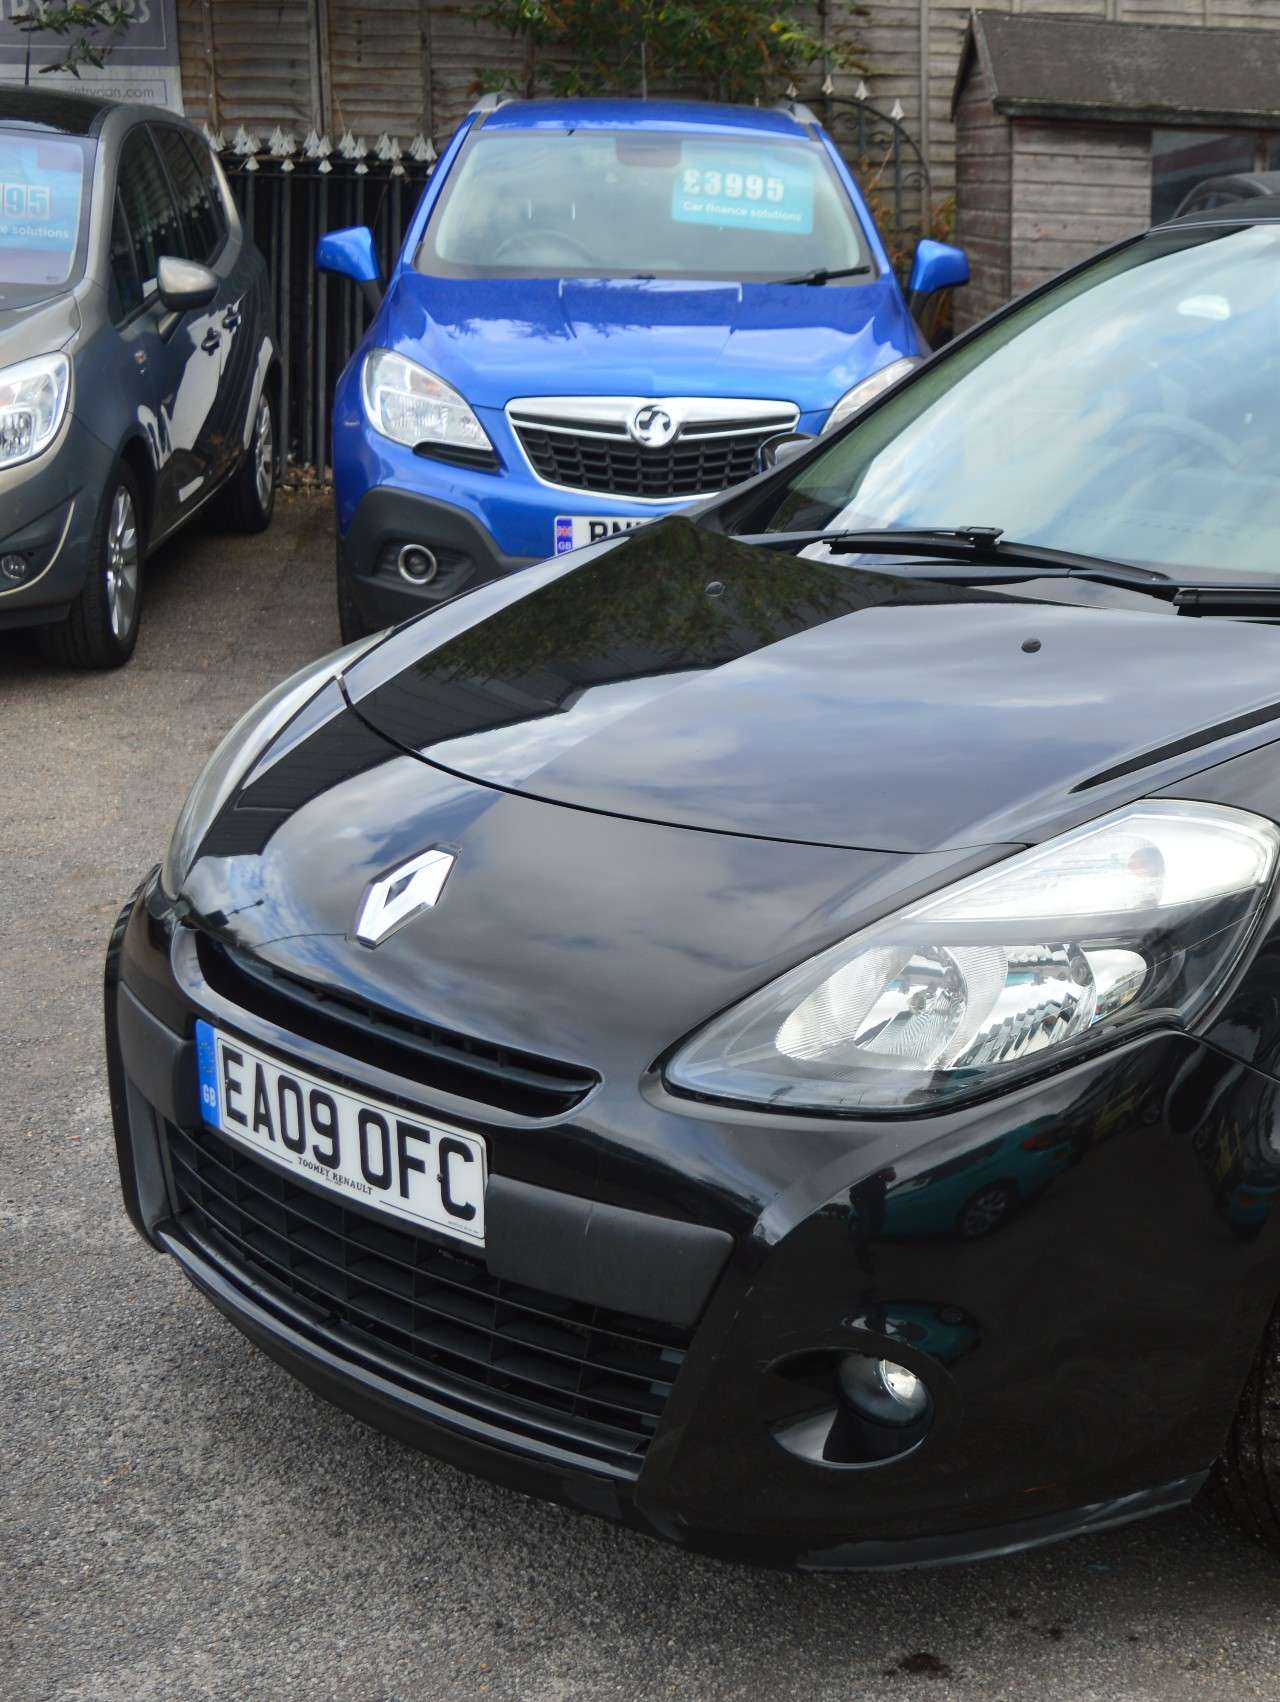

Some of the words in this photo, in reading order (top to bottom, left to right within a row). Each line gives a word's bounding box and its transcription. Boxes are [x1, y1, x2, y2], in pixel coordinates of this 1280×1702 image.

[683, 200, 703, 211] Car
[705, 203, 748, 216] finance
[750, 208, 803, 222] solutions
[12, 224, 69, 240] solutions
[203, 1083, 216, 1107] GB
[221, 1045, 341, 1170] EA09
[358, 1108, 477, 1221] OFC
[298, 1156, 330, 1177] TOOMEY
[332, 1172, 373, 1195] RENAULT
